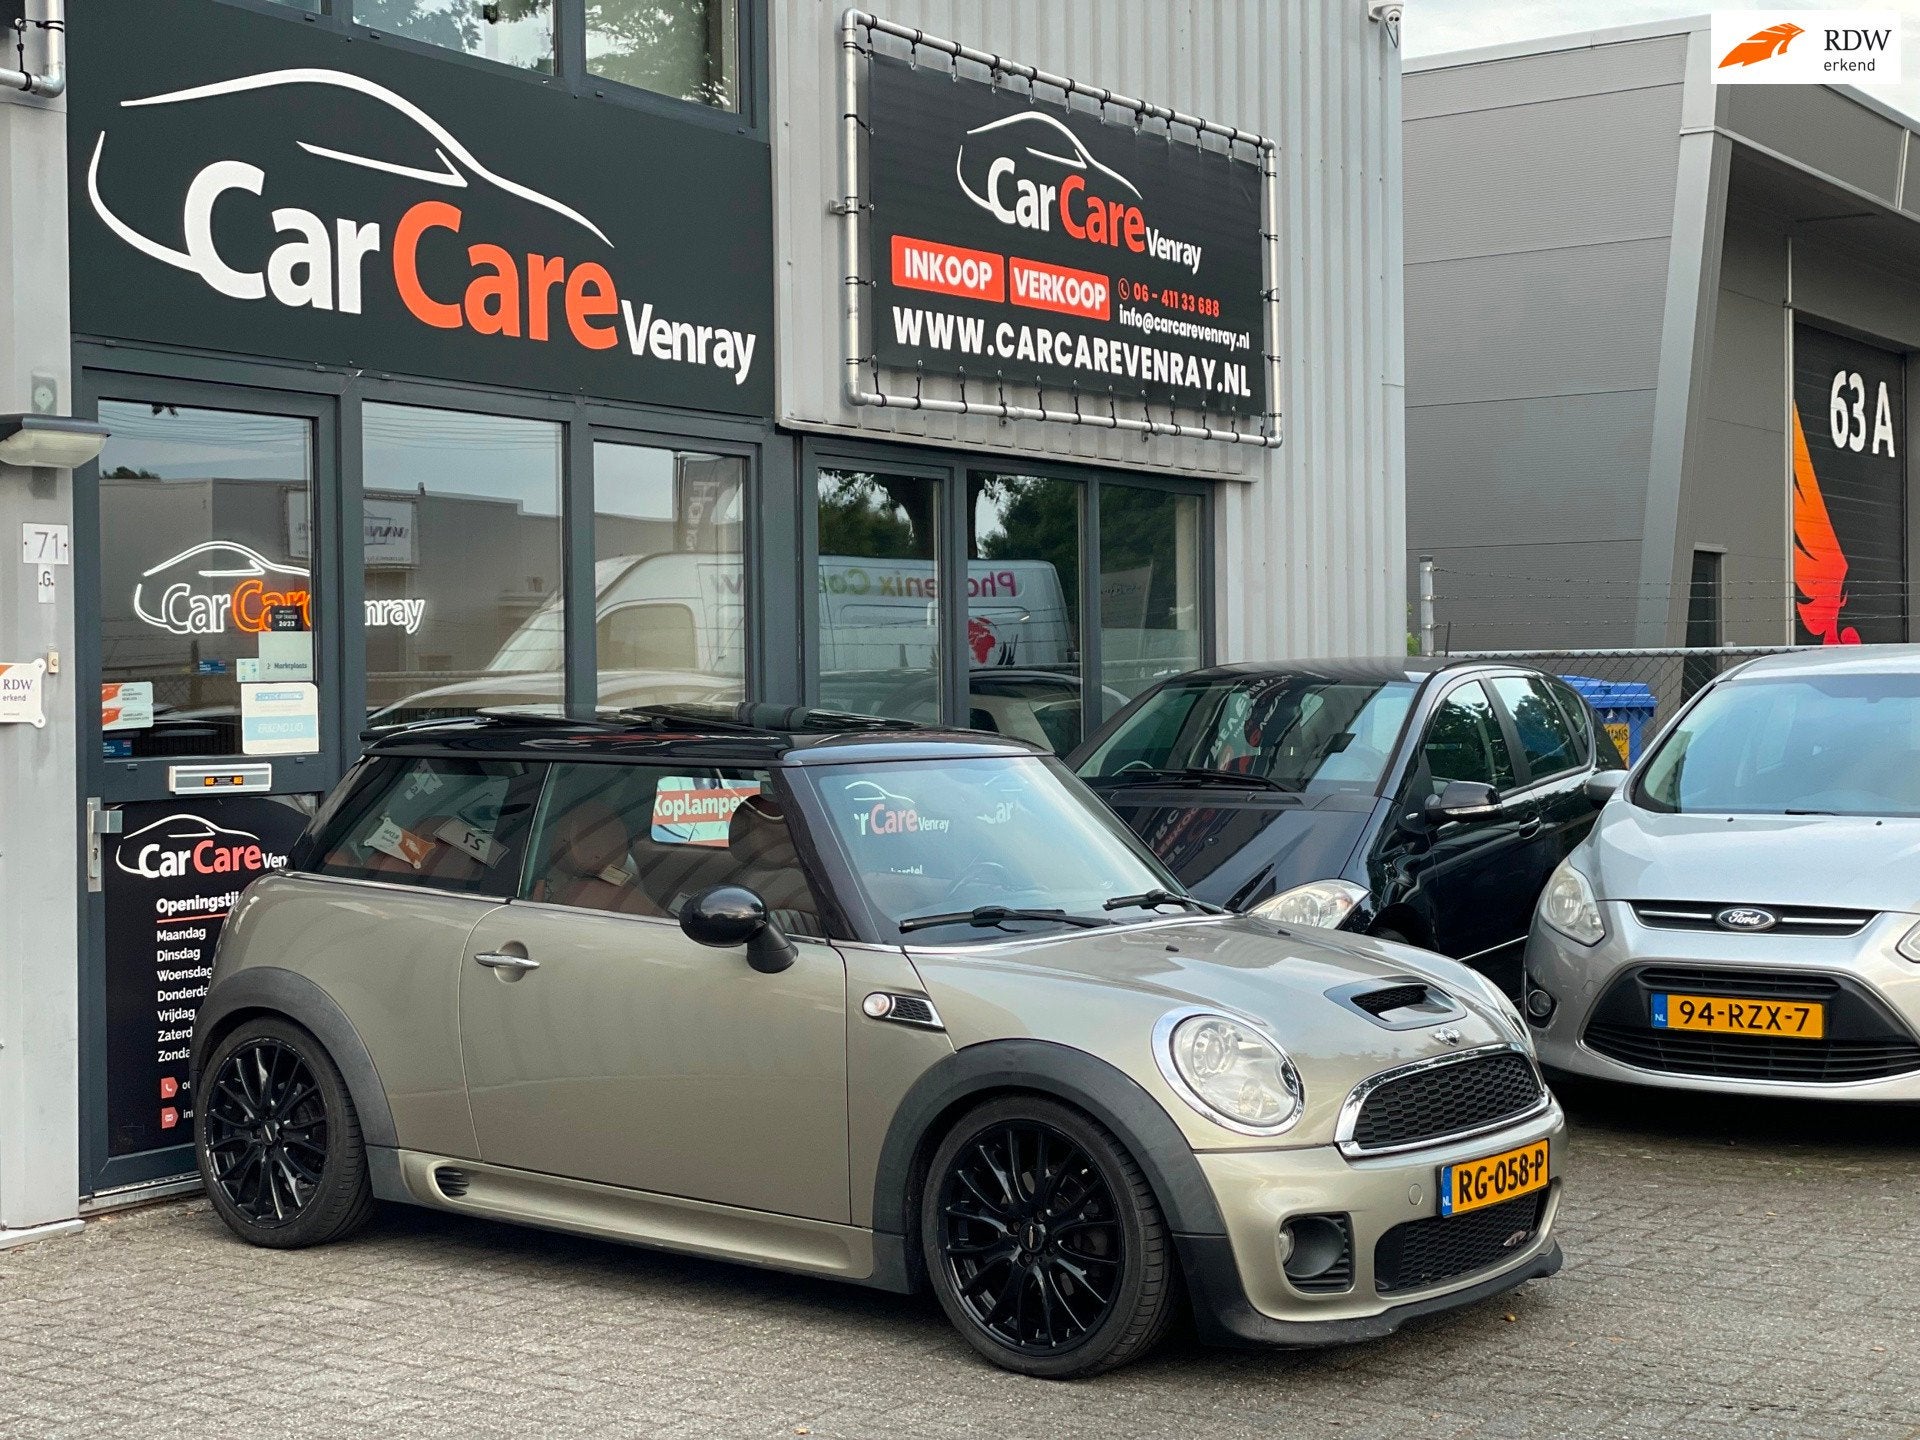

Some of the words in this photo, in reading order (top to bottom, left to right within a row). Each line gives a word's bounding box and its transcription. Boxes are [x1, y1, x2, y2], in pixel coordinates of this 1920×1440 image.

[1146, 227, 1201, 275] Venray
[904, 248, 993, 291] INKOOP
[1013, 267, 1107, 312] VERKOOP
[1133, 282, 1149, 302] 06
[1161, 289, 1179, 309] 411
[1182, 292, 1195, 312] 33
[1199, 297, 1220, 318] 688
[621, 300, 756, 384] Venray
[1119, 304, 1250, 352] info@carcarevenray.nl
[892, 305, 1252, 397] WWW.CARCAREVENRAY.NL
[1829, 370, 1866, 452] 63
[1871, 381, 1896, 457] A
[35, 532, 58, 559] 71
[2, 694, 26, 702] erkend
[3, 679, 33, 690] RDW
[653, 793, 748, 821] Koplampe
[1728, 910, 1761, 925] Ford
[157, 927, 206, 942] Maandag
[157, 948, 201, 962] Dinsdag
[157, 966, 213, 982] Woensdag
[157, 1007, 195, 1023] Vrijdag
[1654, 1013, 1666, 1022] NL
[1679, 1000, 1810, 1031] 94-RZX-7
[1442, 1196, 1452, 1207] NL
[1458, 1148, 1545, 1205] RG-058-P
